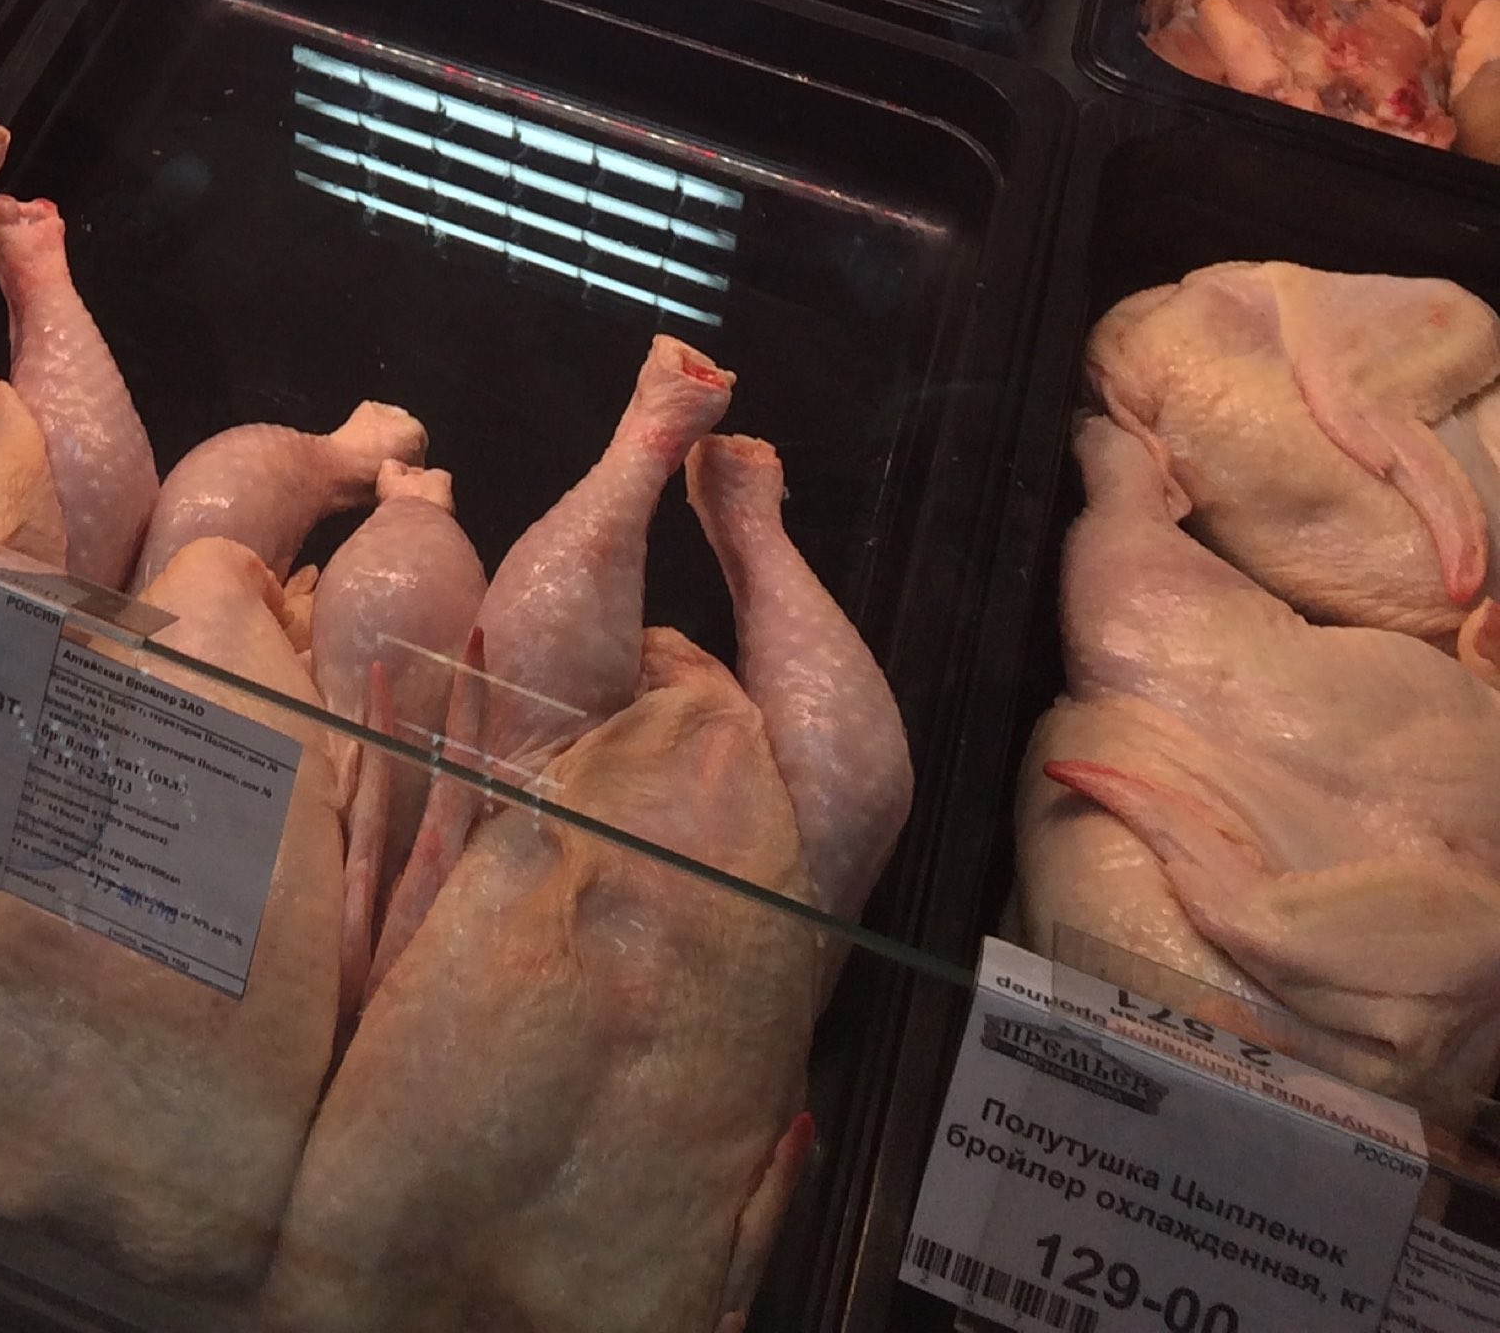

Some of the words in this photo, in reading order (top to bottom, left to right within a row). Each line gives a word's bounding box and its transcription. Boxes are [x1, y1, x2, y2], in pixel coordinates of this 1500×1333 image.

[5, 594, 63, 628] РОССИЯ
[179, 697, 206, 718] ЗАО
[999, 1019, 1156, 1099] ПРЕМЬЕР
[980, 1096, 1162, 1192] Полутушка
[1170, 1171, 1349, 1270] Цыпленок
[1353, 1140, 1424, 1181] РОССИЯ
[944, 1123, 1088, 1202] бройлер
[1096, 1186, 1329, 1305] охлажденная,
[1339, 1284, 1376, 1316] кг
[1035, 1231, 1242, 1333] 129-00
